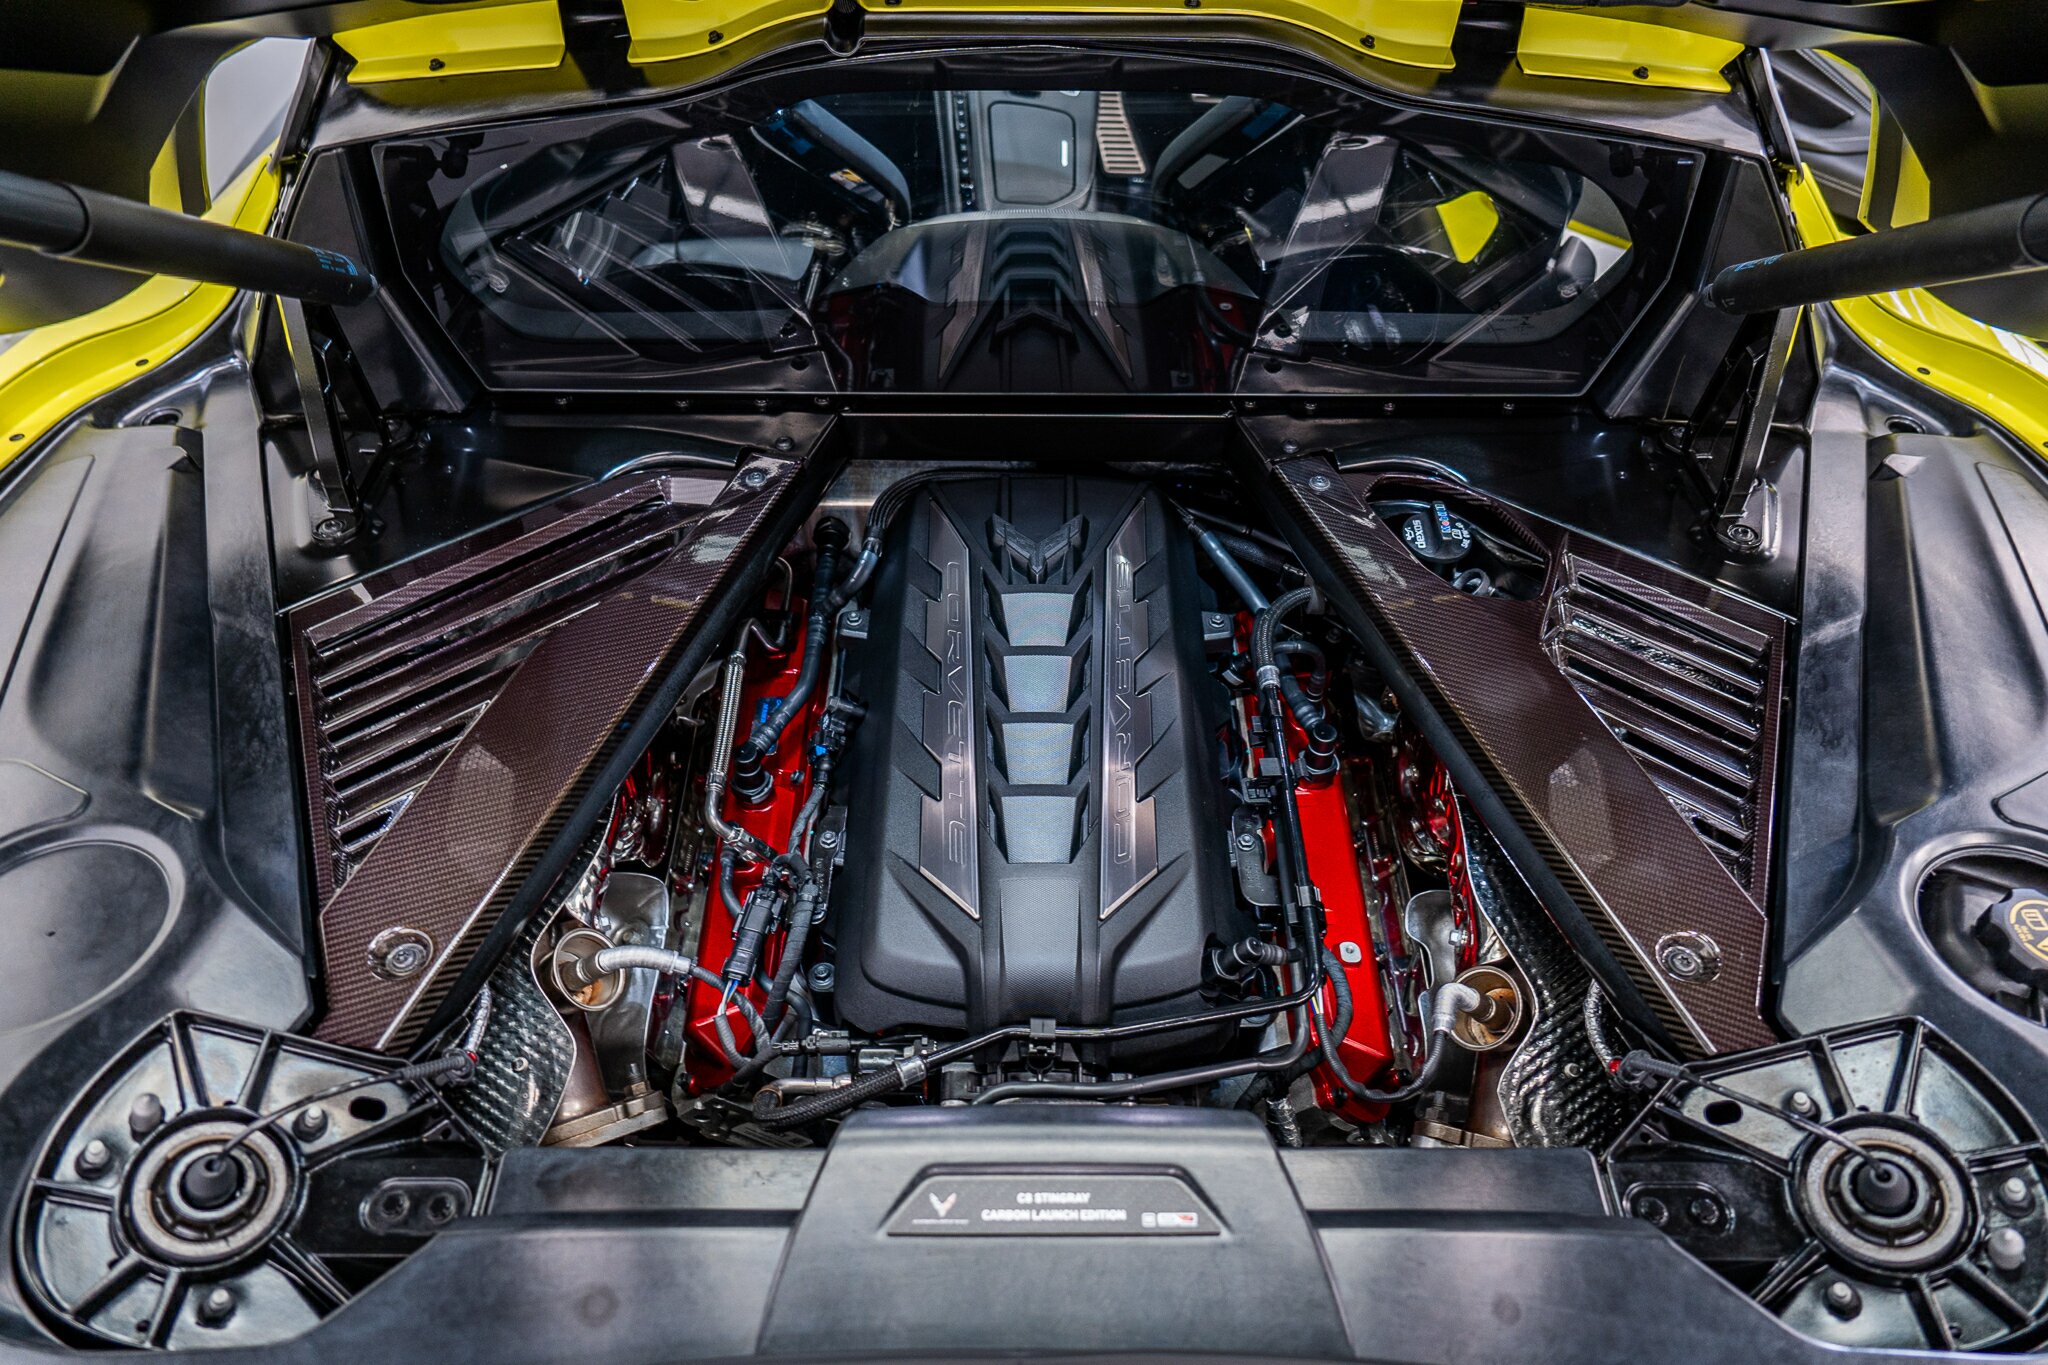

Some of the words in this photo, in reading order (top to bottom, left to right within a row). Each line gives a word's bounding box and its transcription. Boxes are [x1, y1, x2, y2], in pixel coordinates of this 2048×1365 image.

[1412, 519, 1427, 549] dexos
[946, 560, 968, 866] CORVETTE
[1111, 560, 1132, 865] CORVETTE
[1033, 1192, 1091, 1204] STINGRAY
[981, 1208, 1030, 1221] CARBON
[1031, 1208, 1079, 1221] LAUNCH
[1079, 1208, 1127, 1221] EDITION
